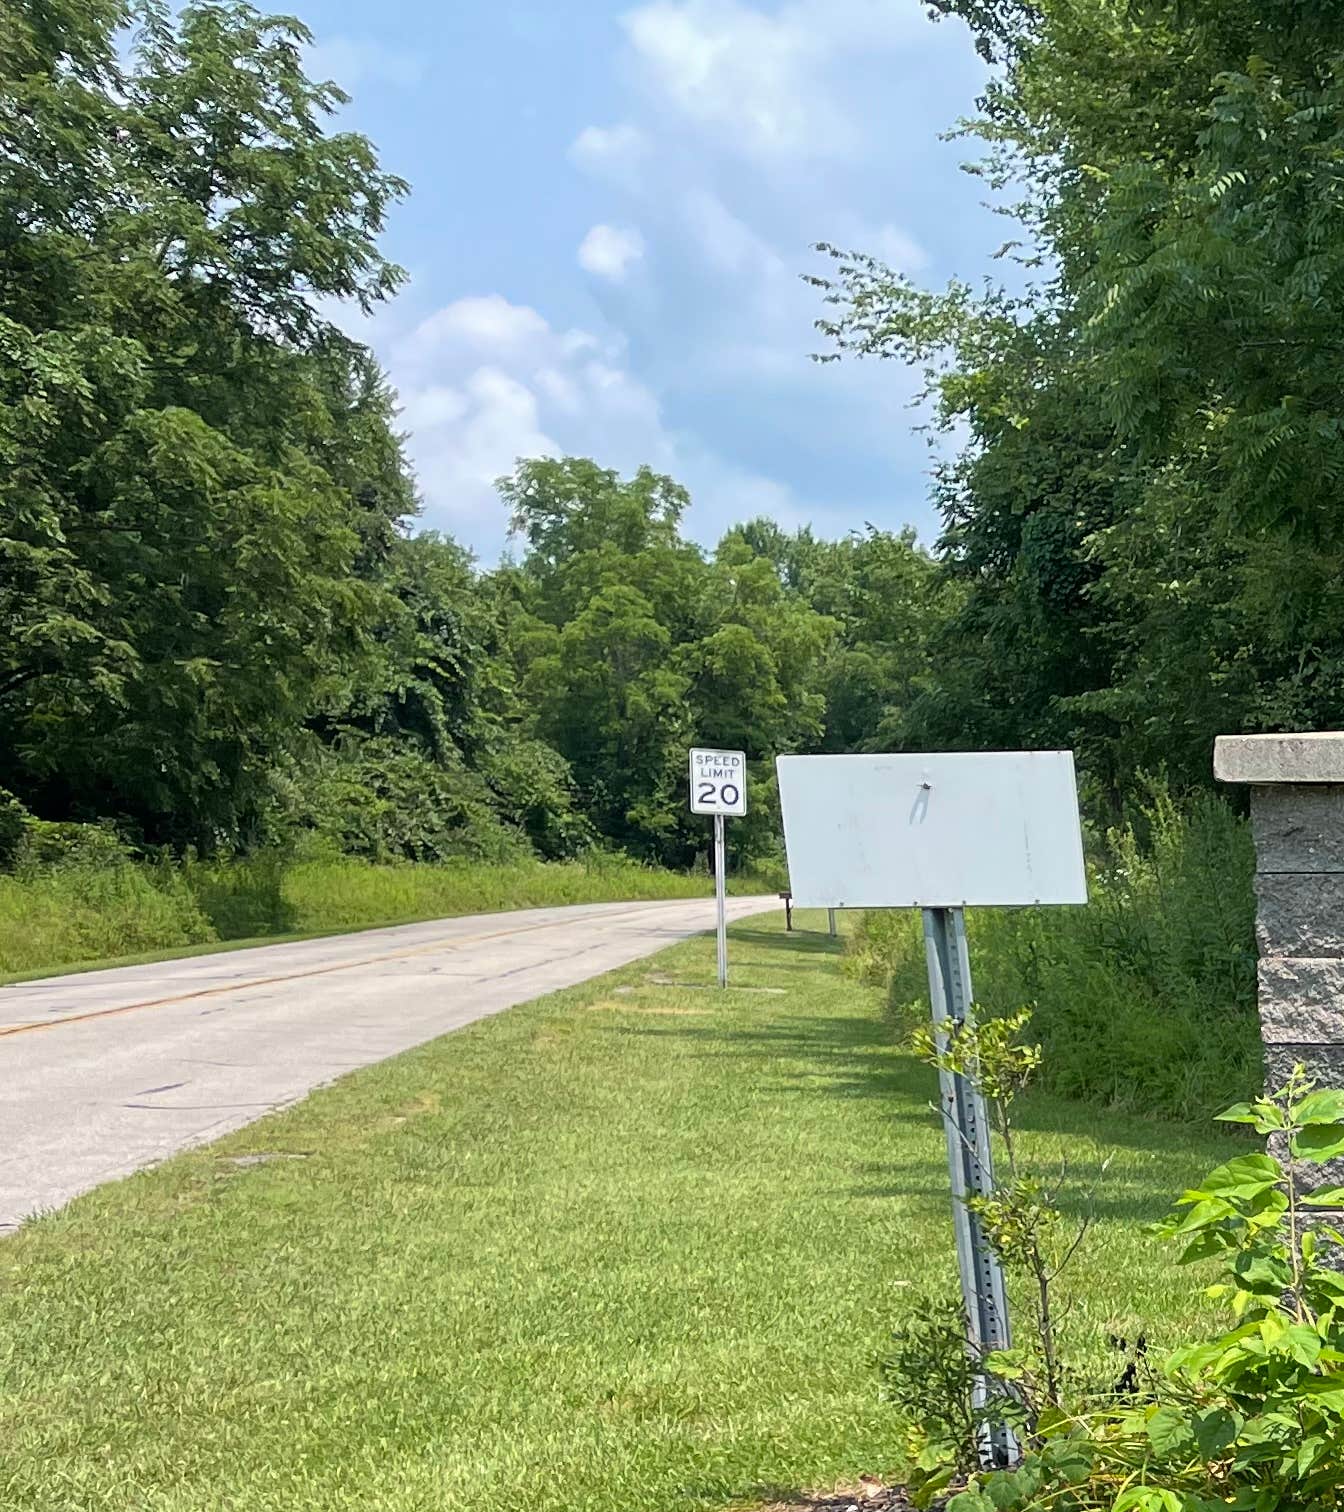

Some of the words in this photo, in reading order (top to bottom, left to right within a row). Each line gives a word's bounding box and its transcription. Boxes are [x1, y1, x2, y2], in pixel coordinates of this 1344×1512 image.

[695, 754, 740, 766] SPEED
[701, 768, 735, 779] LIMIT
[698, 782, 739, 805] 20
